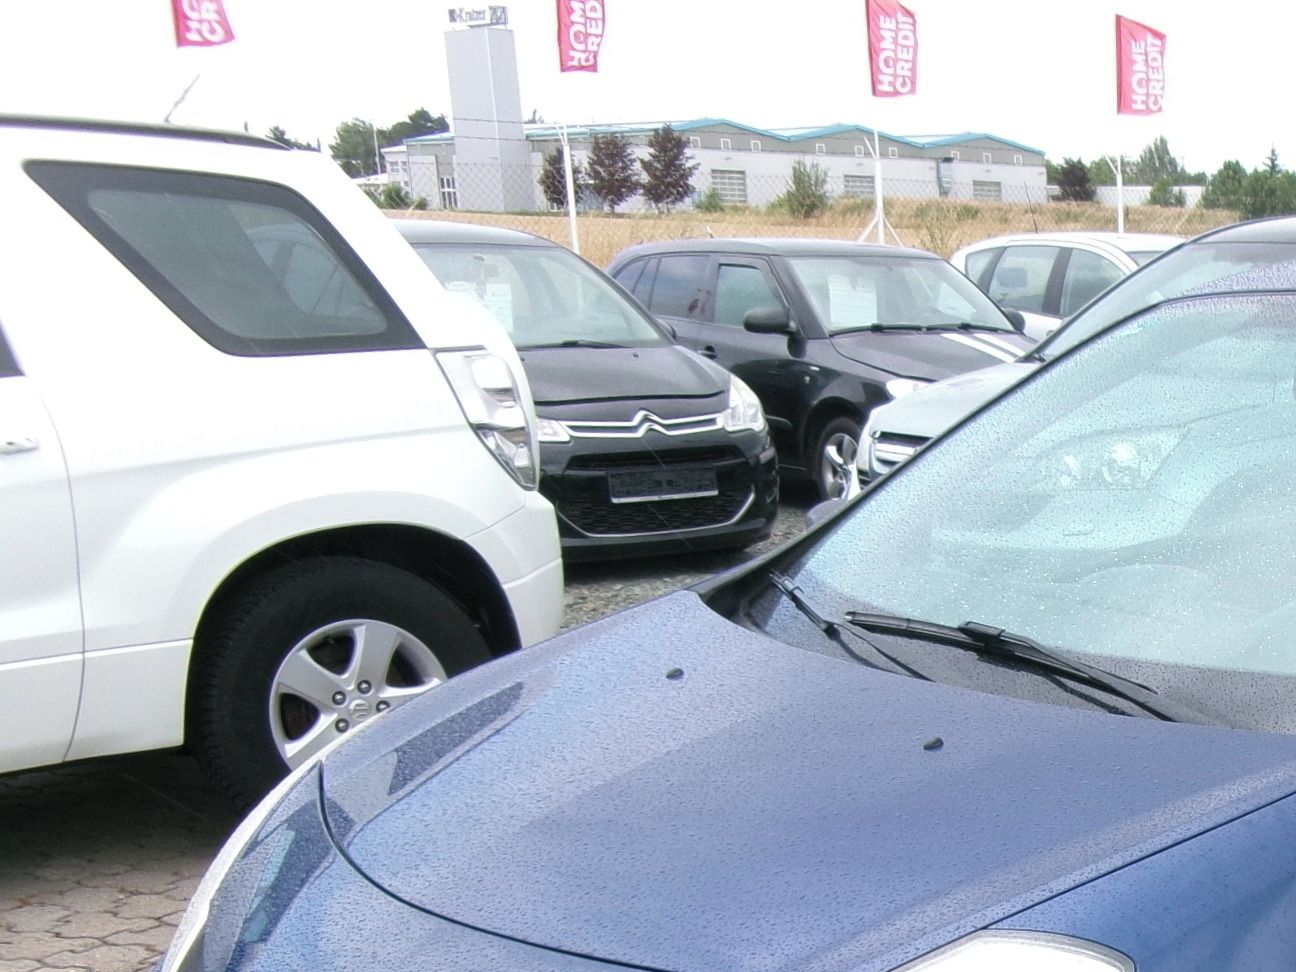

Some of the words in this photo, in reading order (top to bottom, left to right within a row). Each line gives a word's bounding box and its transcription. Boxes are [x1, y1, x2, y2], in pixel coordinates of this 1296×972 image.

[568, 0, 586, 67] HOM
[580, 0, 603, 67] CRED
[878, 14, 897, 92] HOME
[895, 11, 915, 94] CREDIT
[1131, 39, 1148, 112] HOME
[1146, 32, 1164, 112] CREDIT
